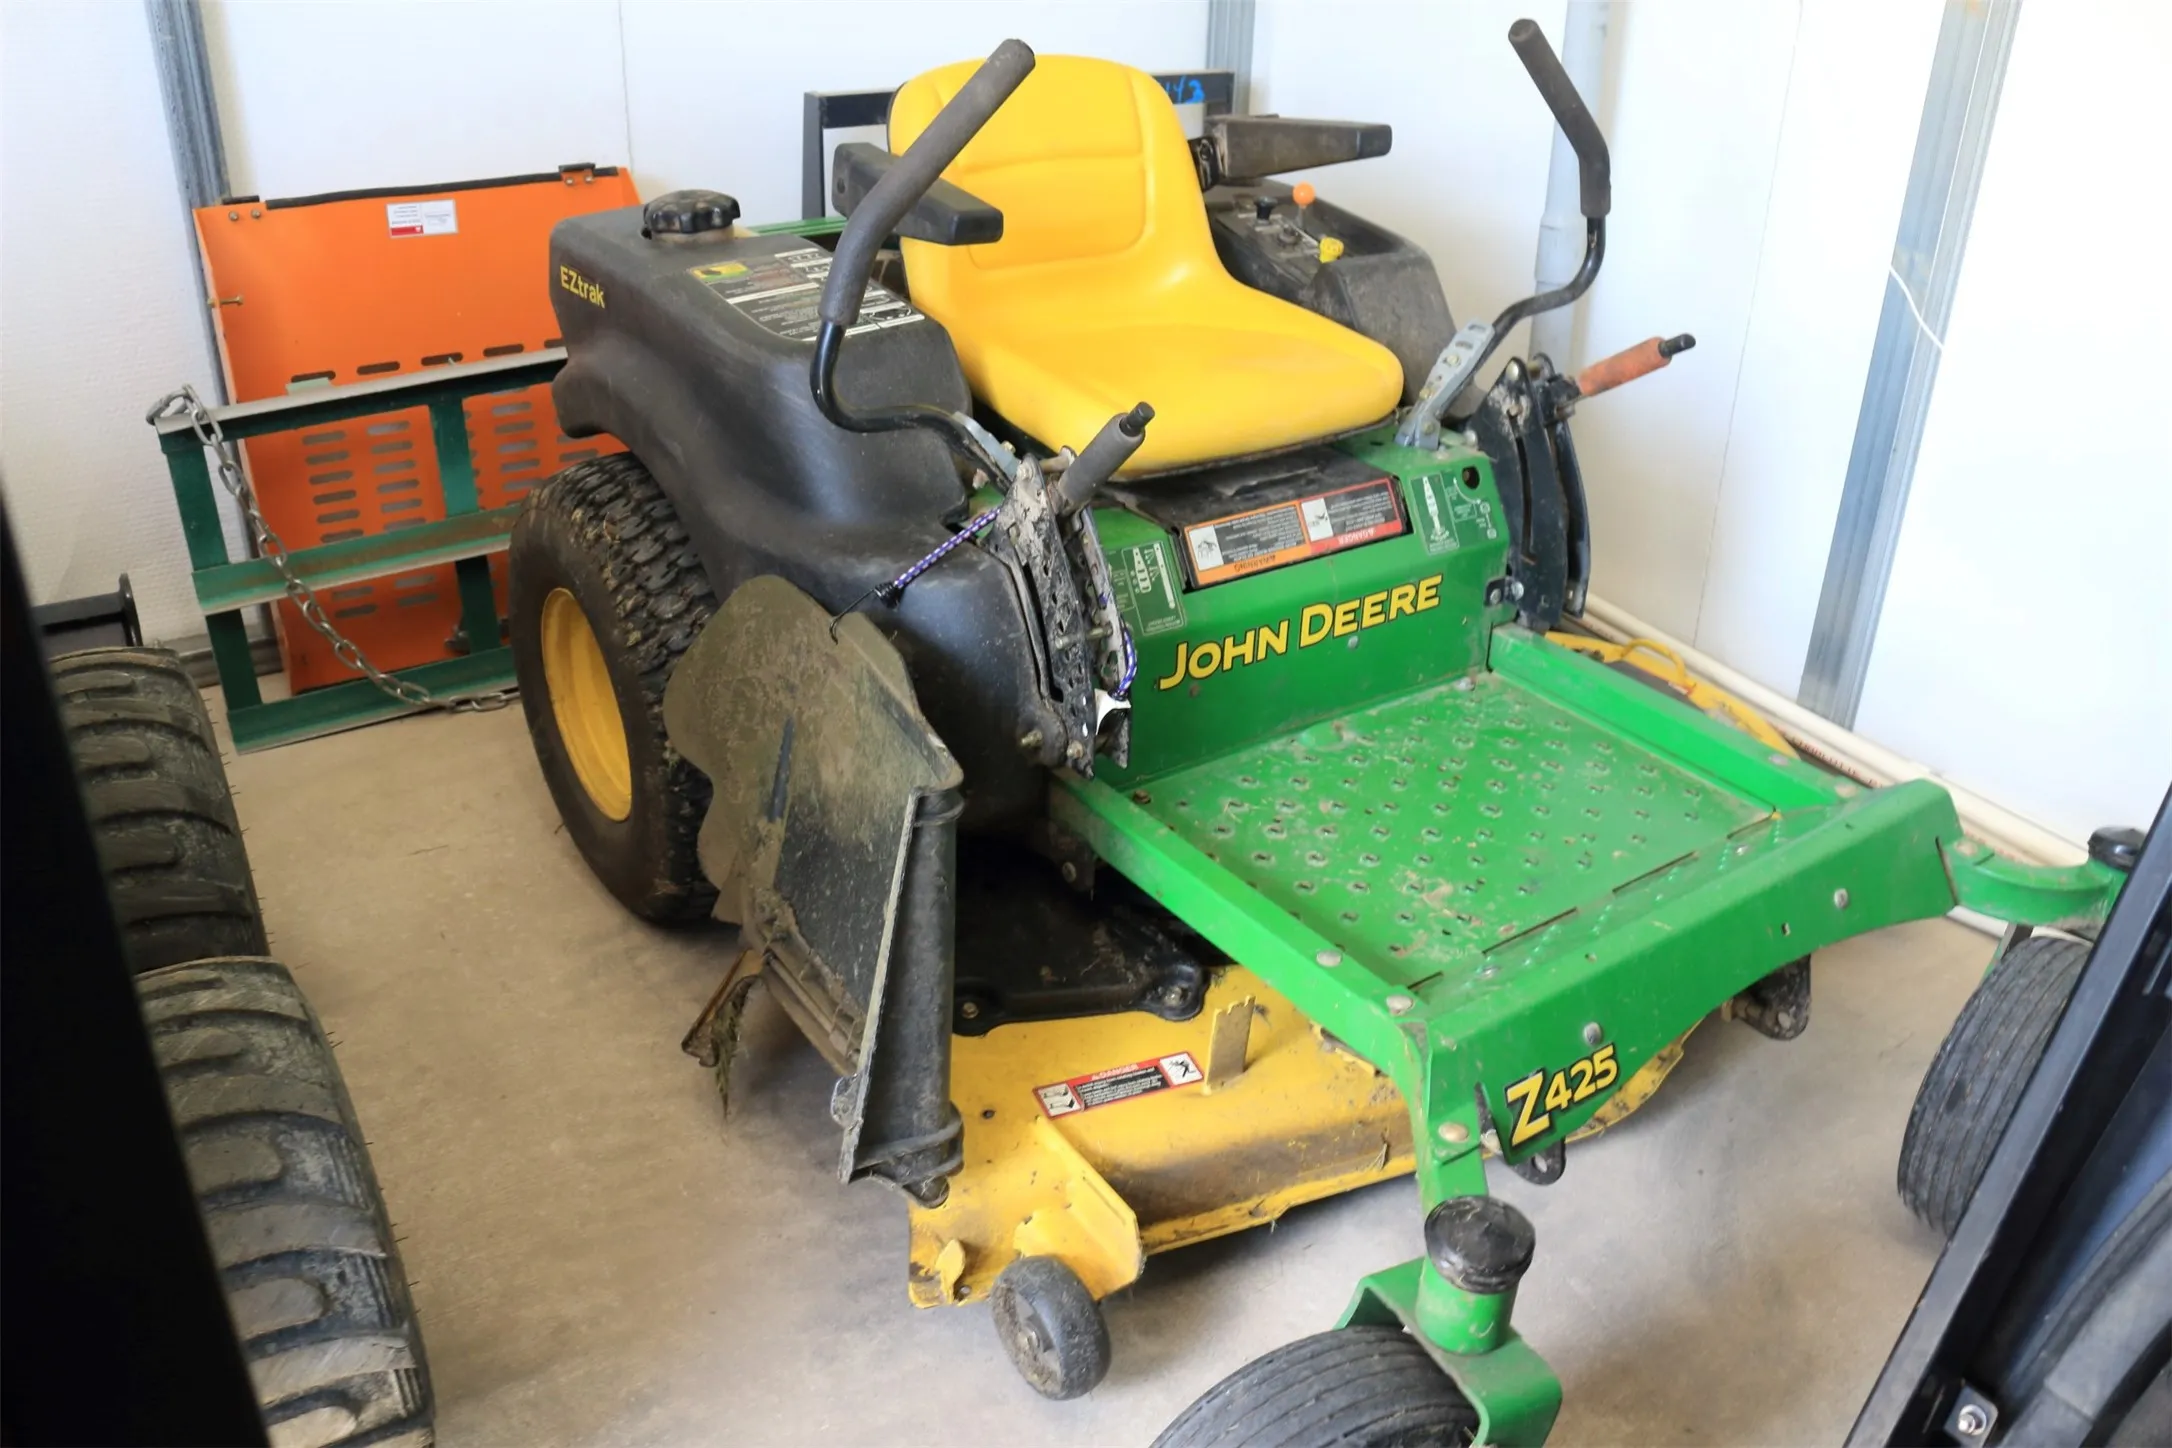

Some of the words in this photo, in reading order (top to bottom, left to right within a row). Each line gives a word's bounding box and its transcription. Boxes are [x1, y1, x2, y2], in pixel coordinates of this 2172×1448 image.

[560, 265, 605, 309] EZtrak
[1158, 619, 1290, 691] JOHN
[1298, 574, 1443, 650] DEERE
[1505, 1042, 1618, 1147] Z425
